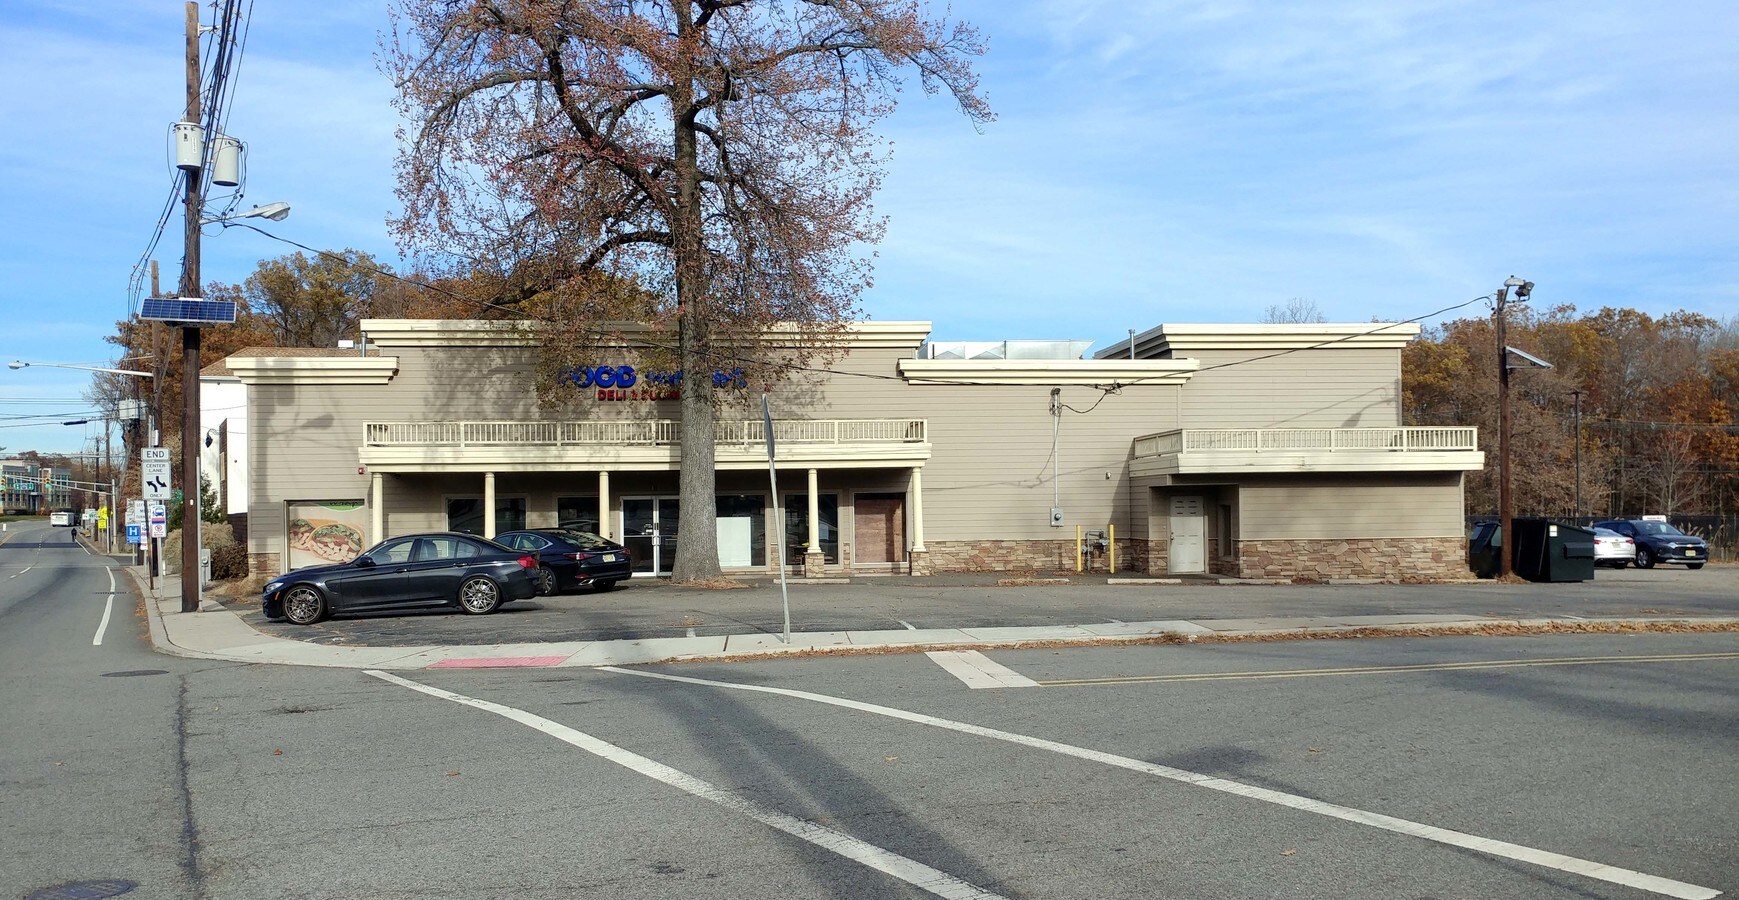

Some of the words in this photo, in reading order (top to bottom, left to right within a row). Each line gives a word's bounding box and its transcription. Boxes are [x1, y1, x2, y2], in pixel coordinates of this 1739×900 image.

[559, 365, 637, 388] OOD
[598, 389, 626, 401] DELI
[129, 527, 138, 536] H
